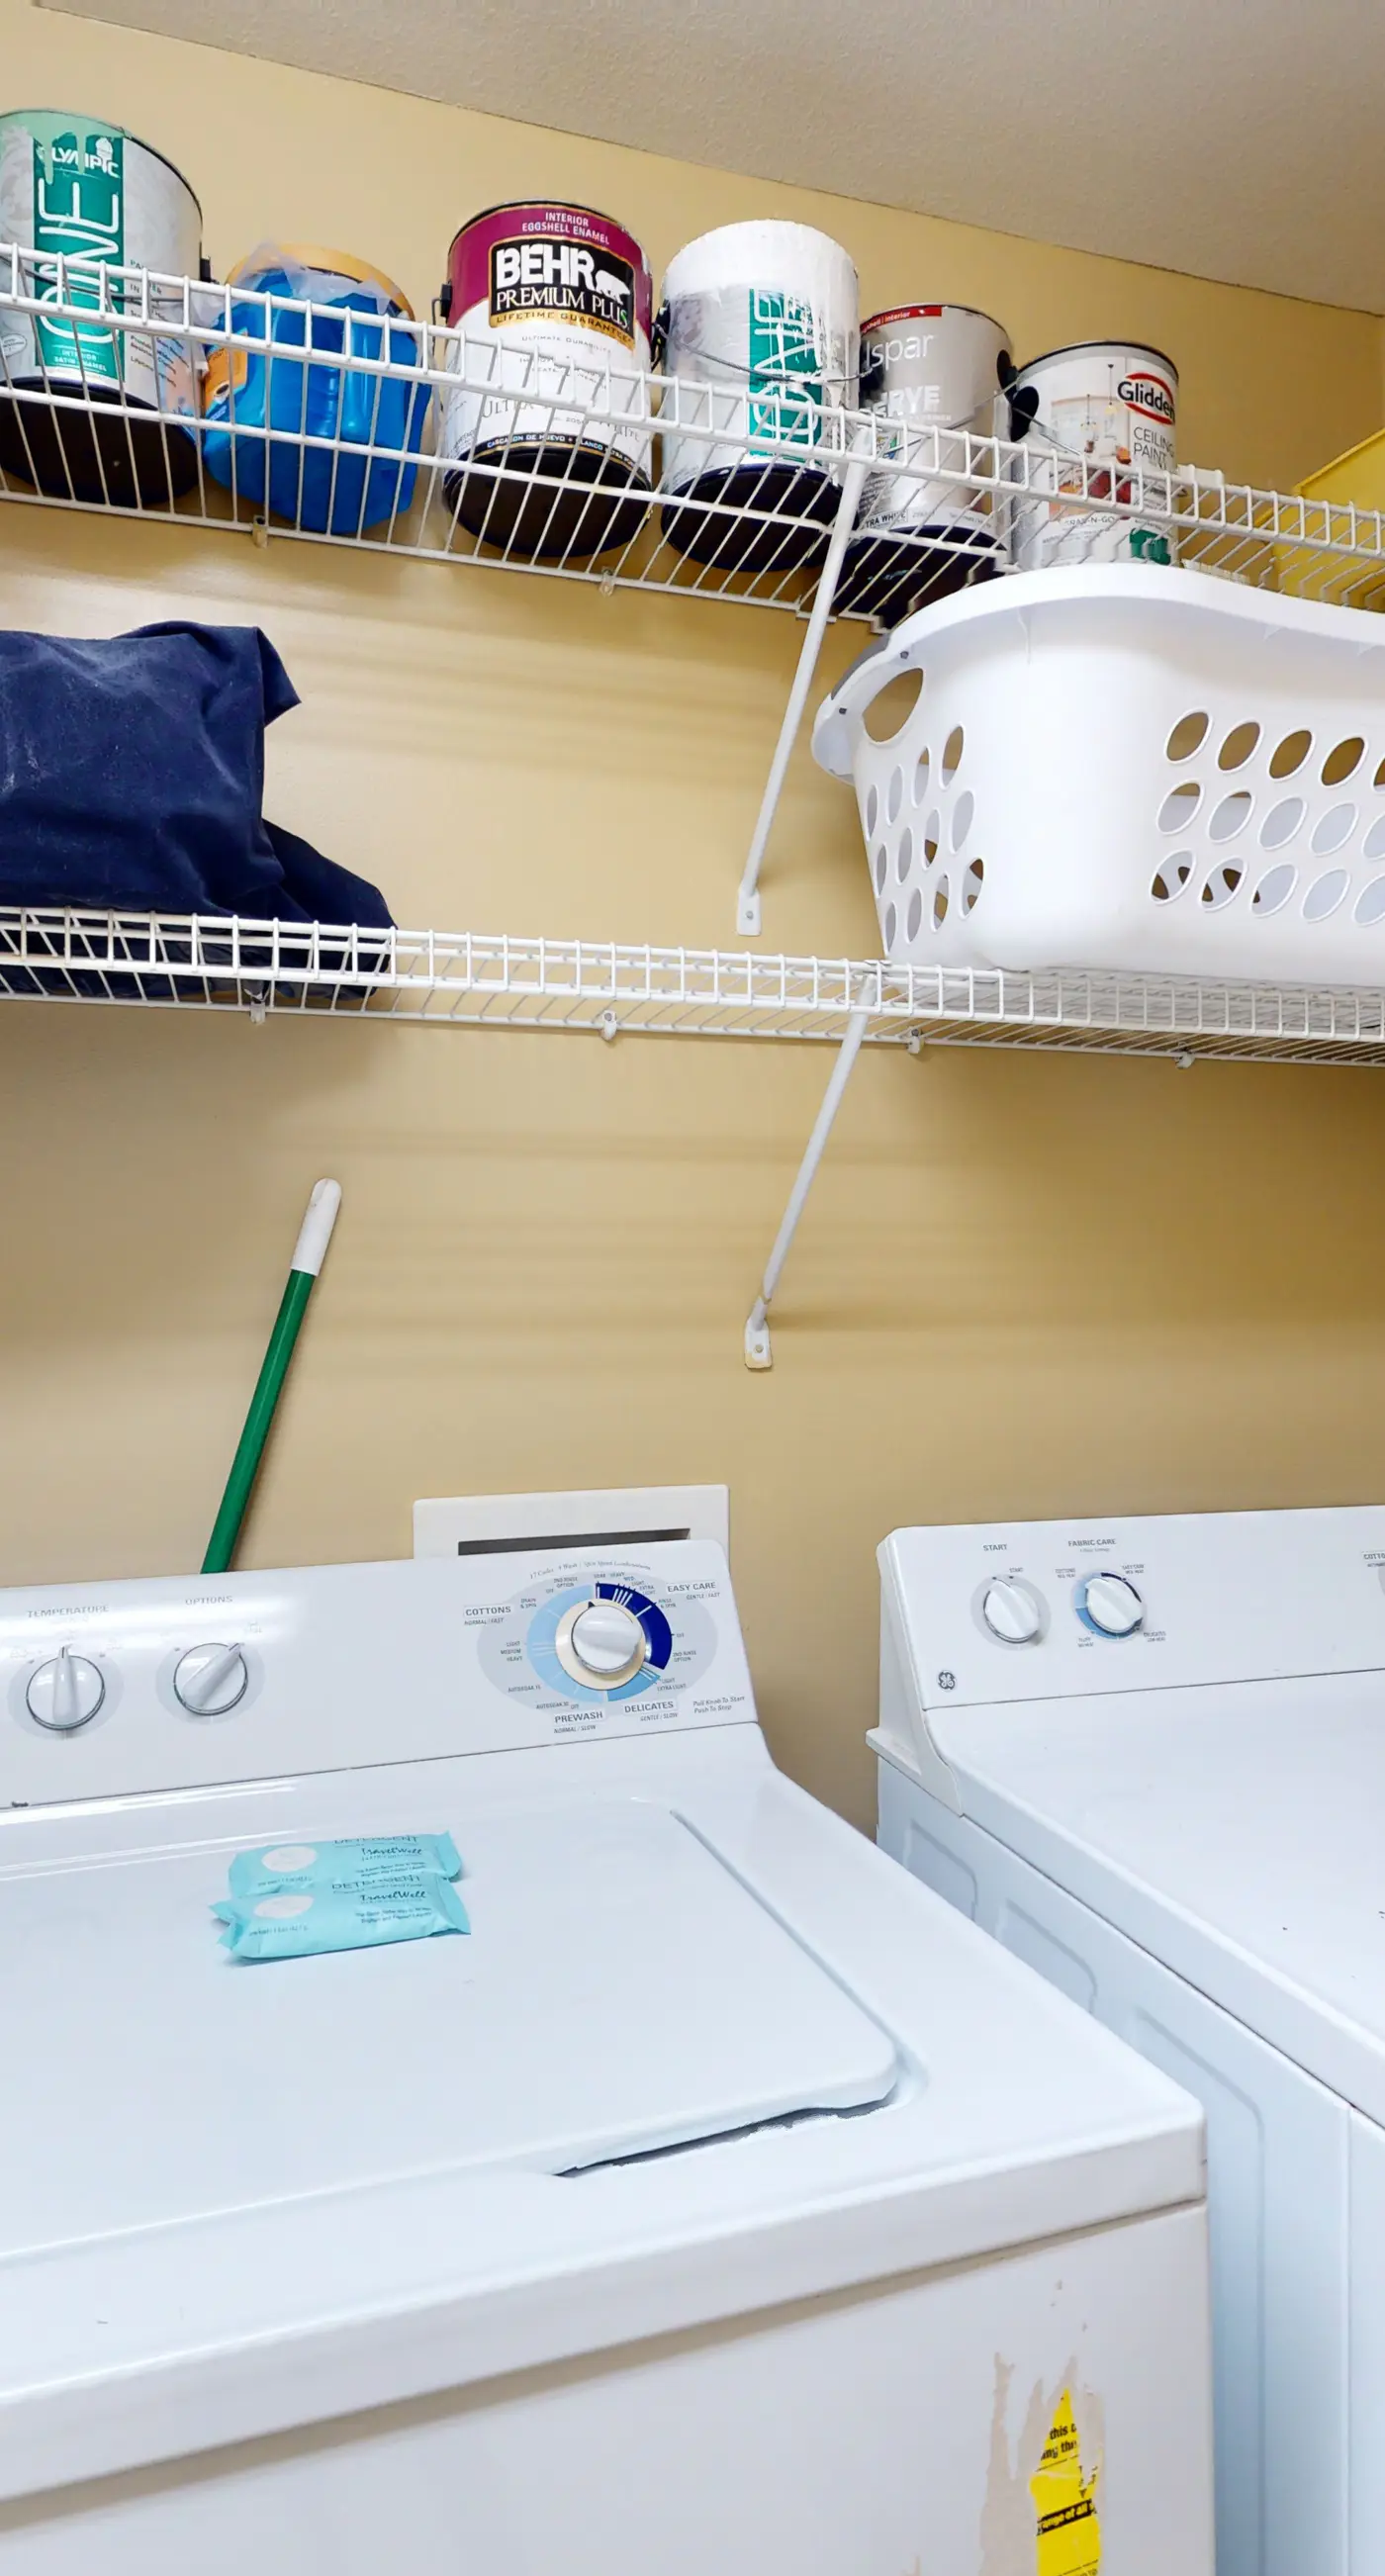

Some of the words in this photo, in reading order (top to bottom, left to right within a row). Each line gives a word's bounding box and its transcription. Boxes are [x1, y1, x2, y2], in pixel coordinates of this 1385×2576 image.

[545, 212, 590, 227] INTERIOR
[521, 223, 570, 234] EGGSHELL
[573, 228, 610, 245] ENAMEL
[496, 243, 601, 291] BEHR
[497, 286, 586, 311] PREMIUM
[593, 295, 629, 329] PLUS
[497, 312, 555, 323] LIFETIME
[61, 349, 97, 361] INTEIOR
[866, 333, 935, 372] lspar
[1117, 381, 1175, 418] Glidden
[486, 434, 523, 449] CASCAON
[578, 438, 603, 451] LANCO
[1133, 442, 1167, 470] PAINT
[982, 1543, 1008, 1552] START
[667, 1584, 692, 1593] EASY
[692, 1582, 716, 1592] CARE
[185, 1595, 233, 1606] OPTIONS
[27, 1605, 110, 1618] TEMPERATURE
[465, 1606, 511, 1616] COTTONS
[624, 1701, 675, 1713] DELICATES
[554, 1710, 603, 1723] PREWASH
[359, 1889, 427, 1901] TravelWell
[1049, 2425, 1068, 2440] this
